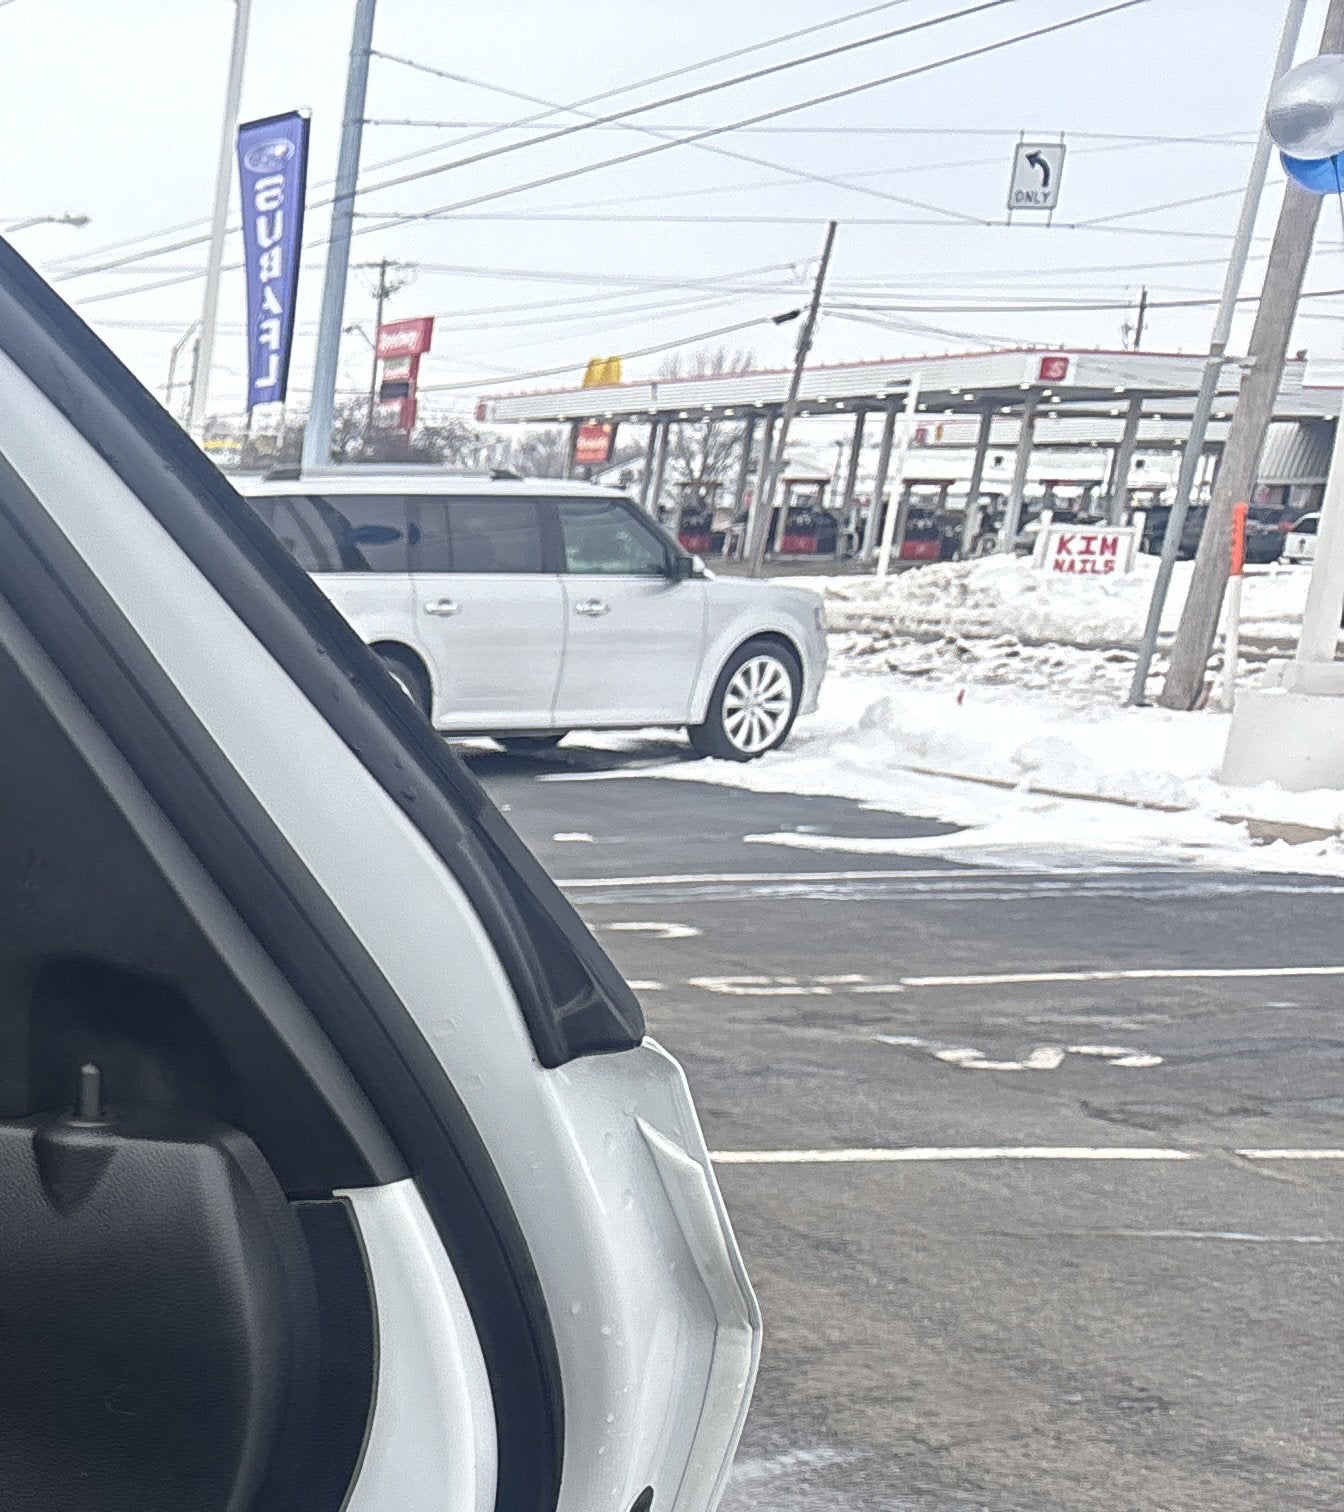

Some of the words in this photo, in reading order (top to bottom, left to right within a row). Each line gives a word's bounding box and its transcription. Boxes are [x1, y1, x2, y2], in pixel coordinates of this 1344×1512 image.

[1015, 190, 1051, 204] ONLY
[1056, 535, 1119, 556] KIM
[1053, 558, 1116, 575] NAILS
